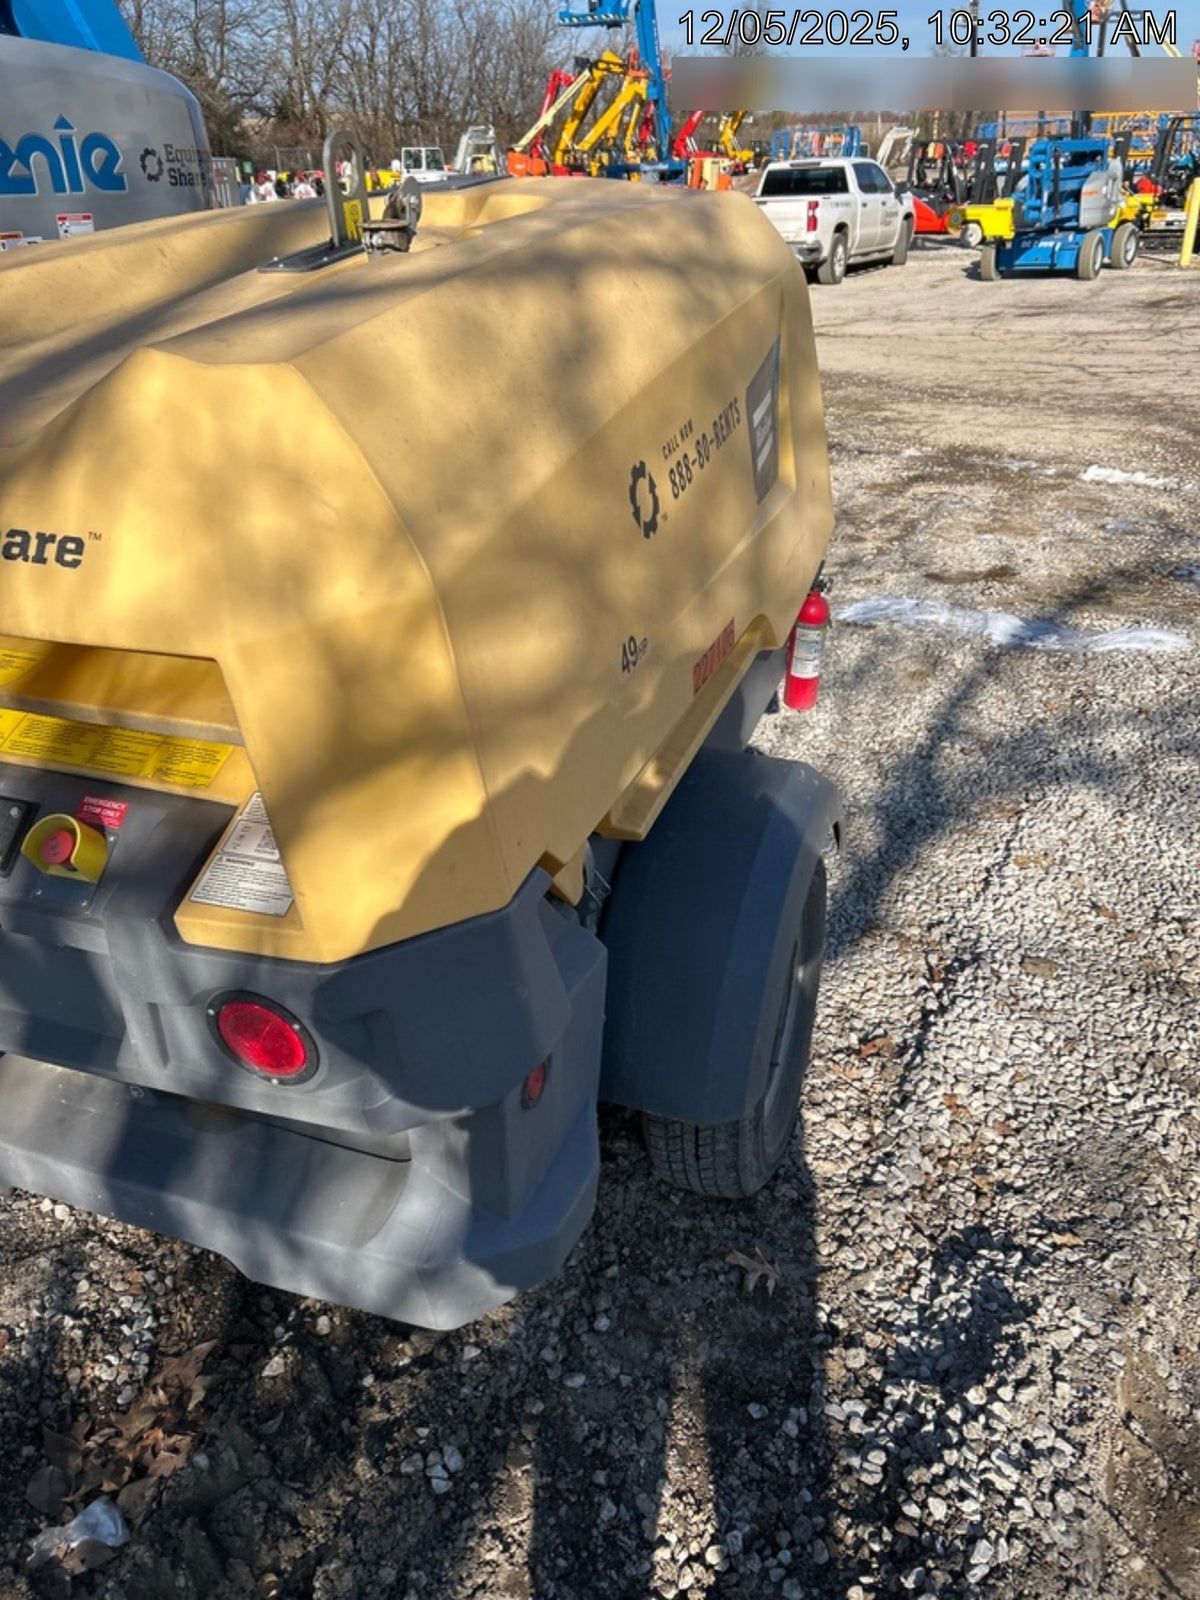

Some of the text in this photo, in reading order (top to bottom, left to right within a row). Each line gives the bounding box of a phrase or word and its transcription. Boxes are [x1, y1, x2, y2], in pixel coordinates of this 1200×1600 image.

[167, 167, 206, 187] Share
[662, 418, 693, 460] CALL NOW
[668, 396, 741, 500] 888-80-RENTS
[83, 805, 121, 817] STOP ONLY
[84, 796, 128, 810] EMERGENCY
